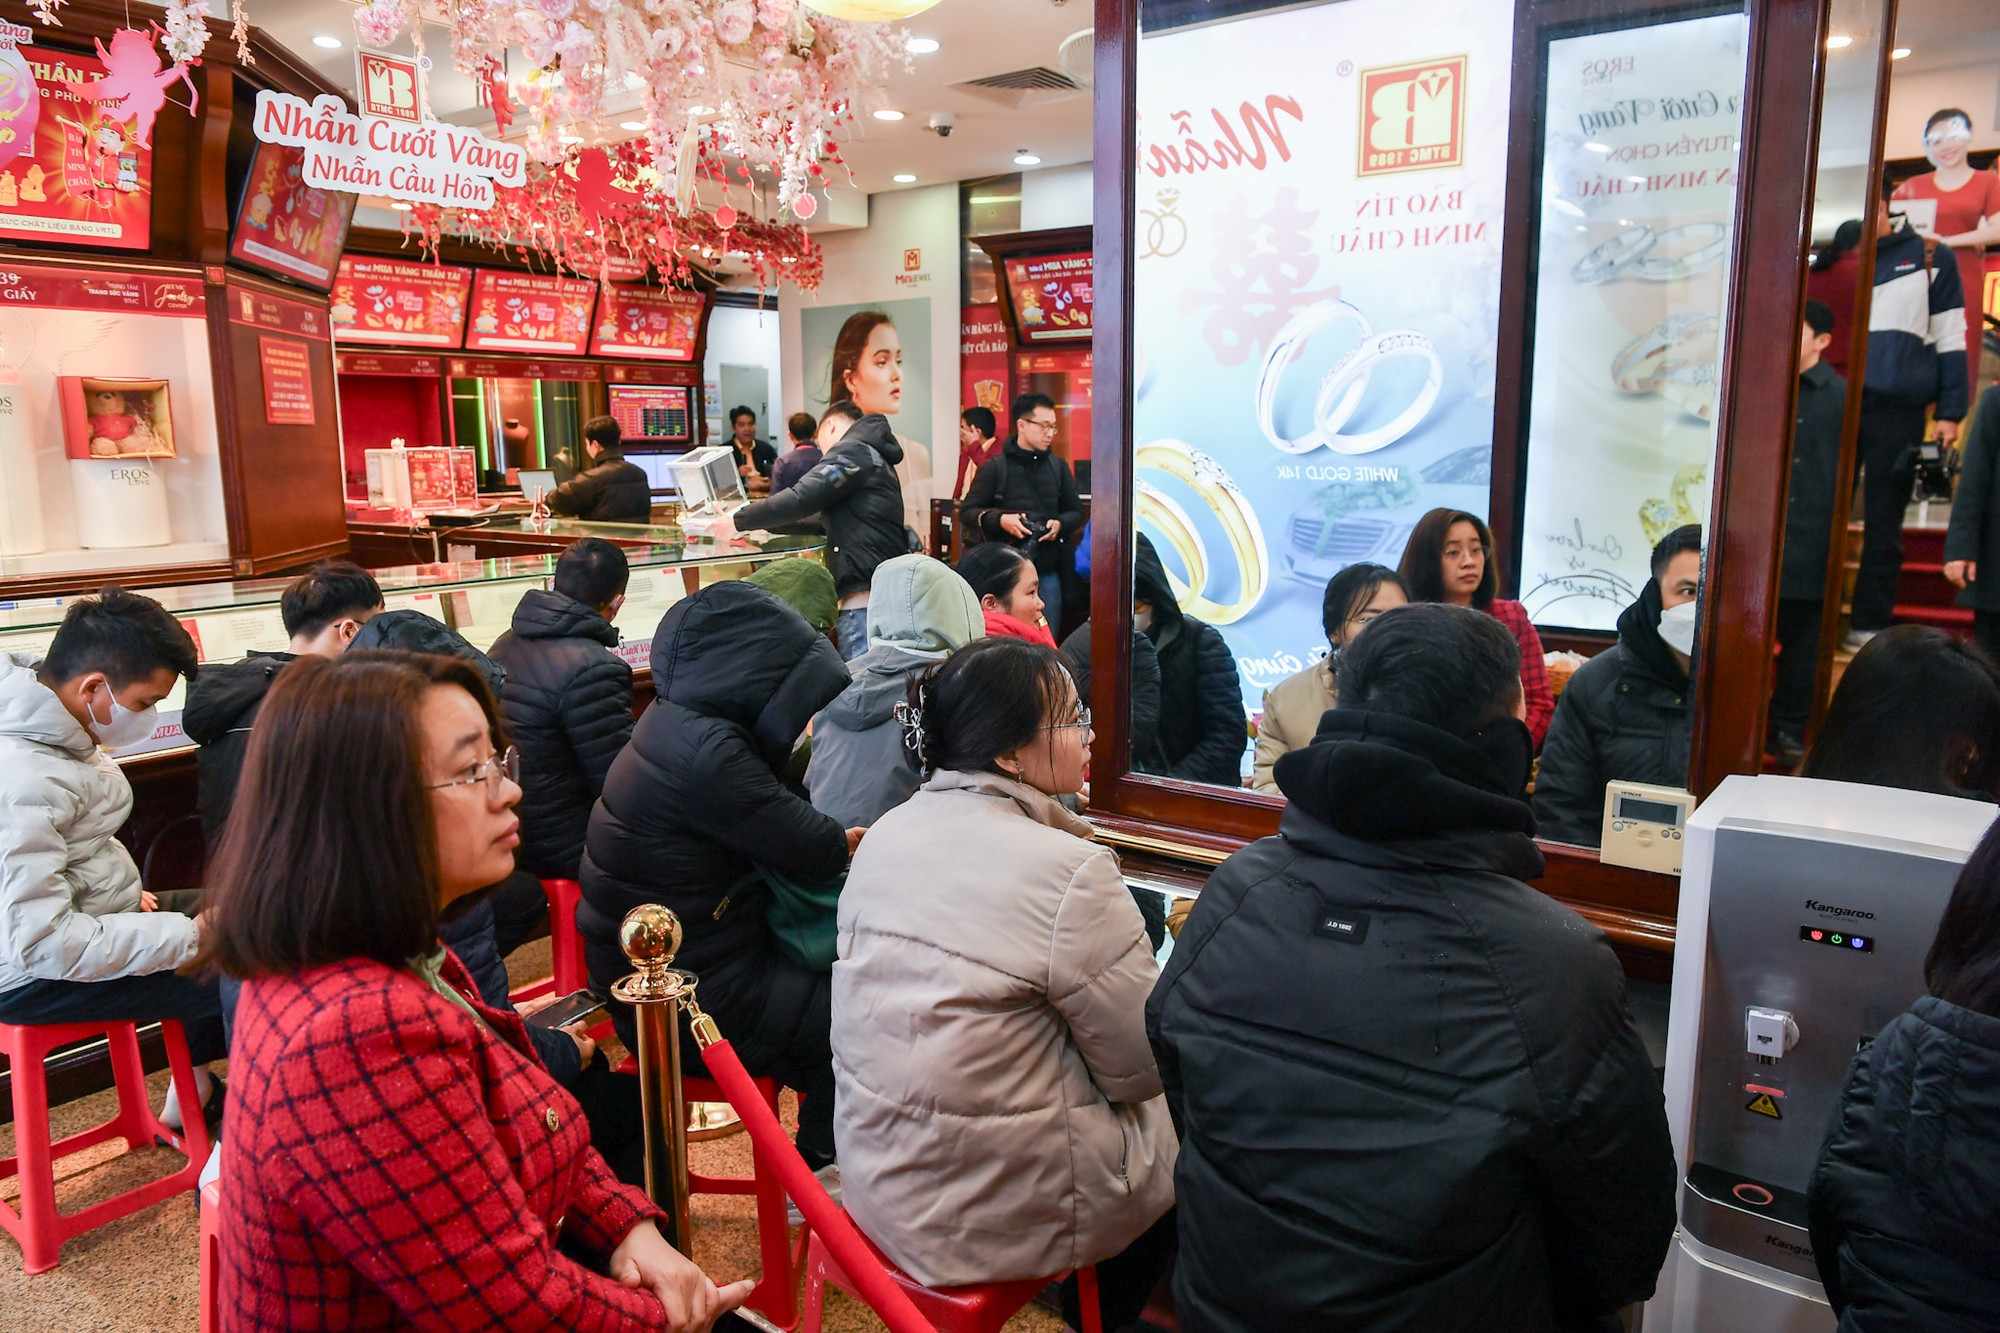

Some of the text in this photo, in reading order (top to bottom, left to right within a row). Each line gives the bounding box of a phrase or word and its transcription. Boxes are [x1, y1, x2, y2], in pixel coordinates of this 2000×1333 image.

[0, 20, 30, 41] àng
[370, 103, 415, 118] BTMC 1989
[263, 100, 520, 178] Nhẫn Cưới Vàng
[311, 154, 488, 202] Nhẫn Cầu Hôn
[372, 264, 393, 274] MUA
[394, 265, 420, 276] VÀNG
[0, 272, 19, 285] 39
[3, 285, 37, 301] GIẤY
[110, 468, 149, 481] EROS
[640, 642, 651, 653] Và
[151, 723, 183, 739] MUA
[1804, 899, 1875, 920] Kangaroo
[1765, 1235, 1814, 1257] Kangar
